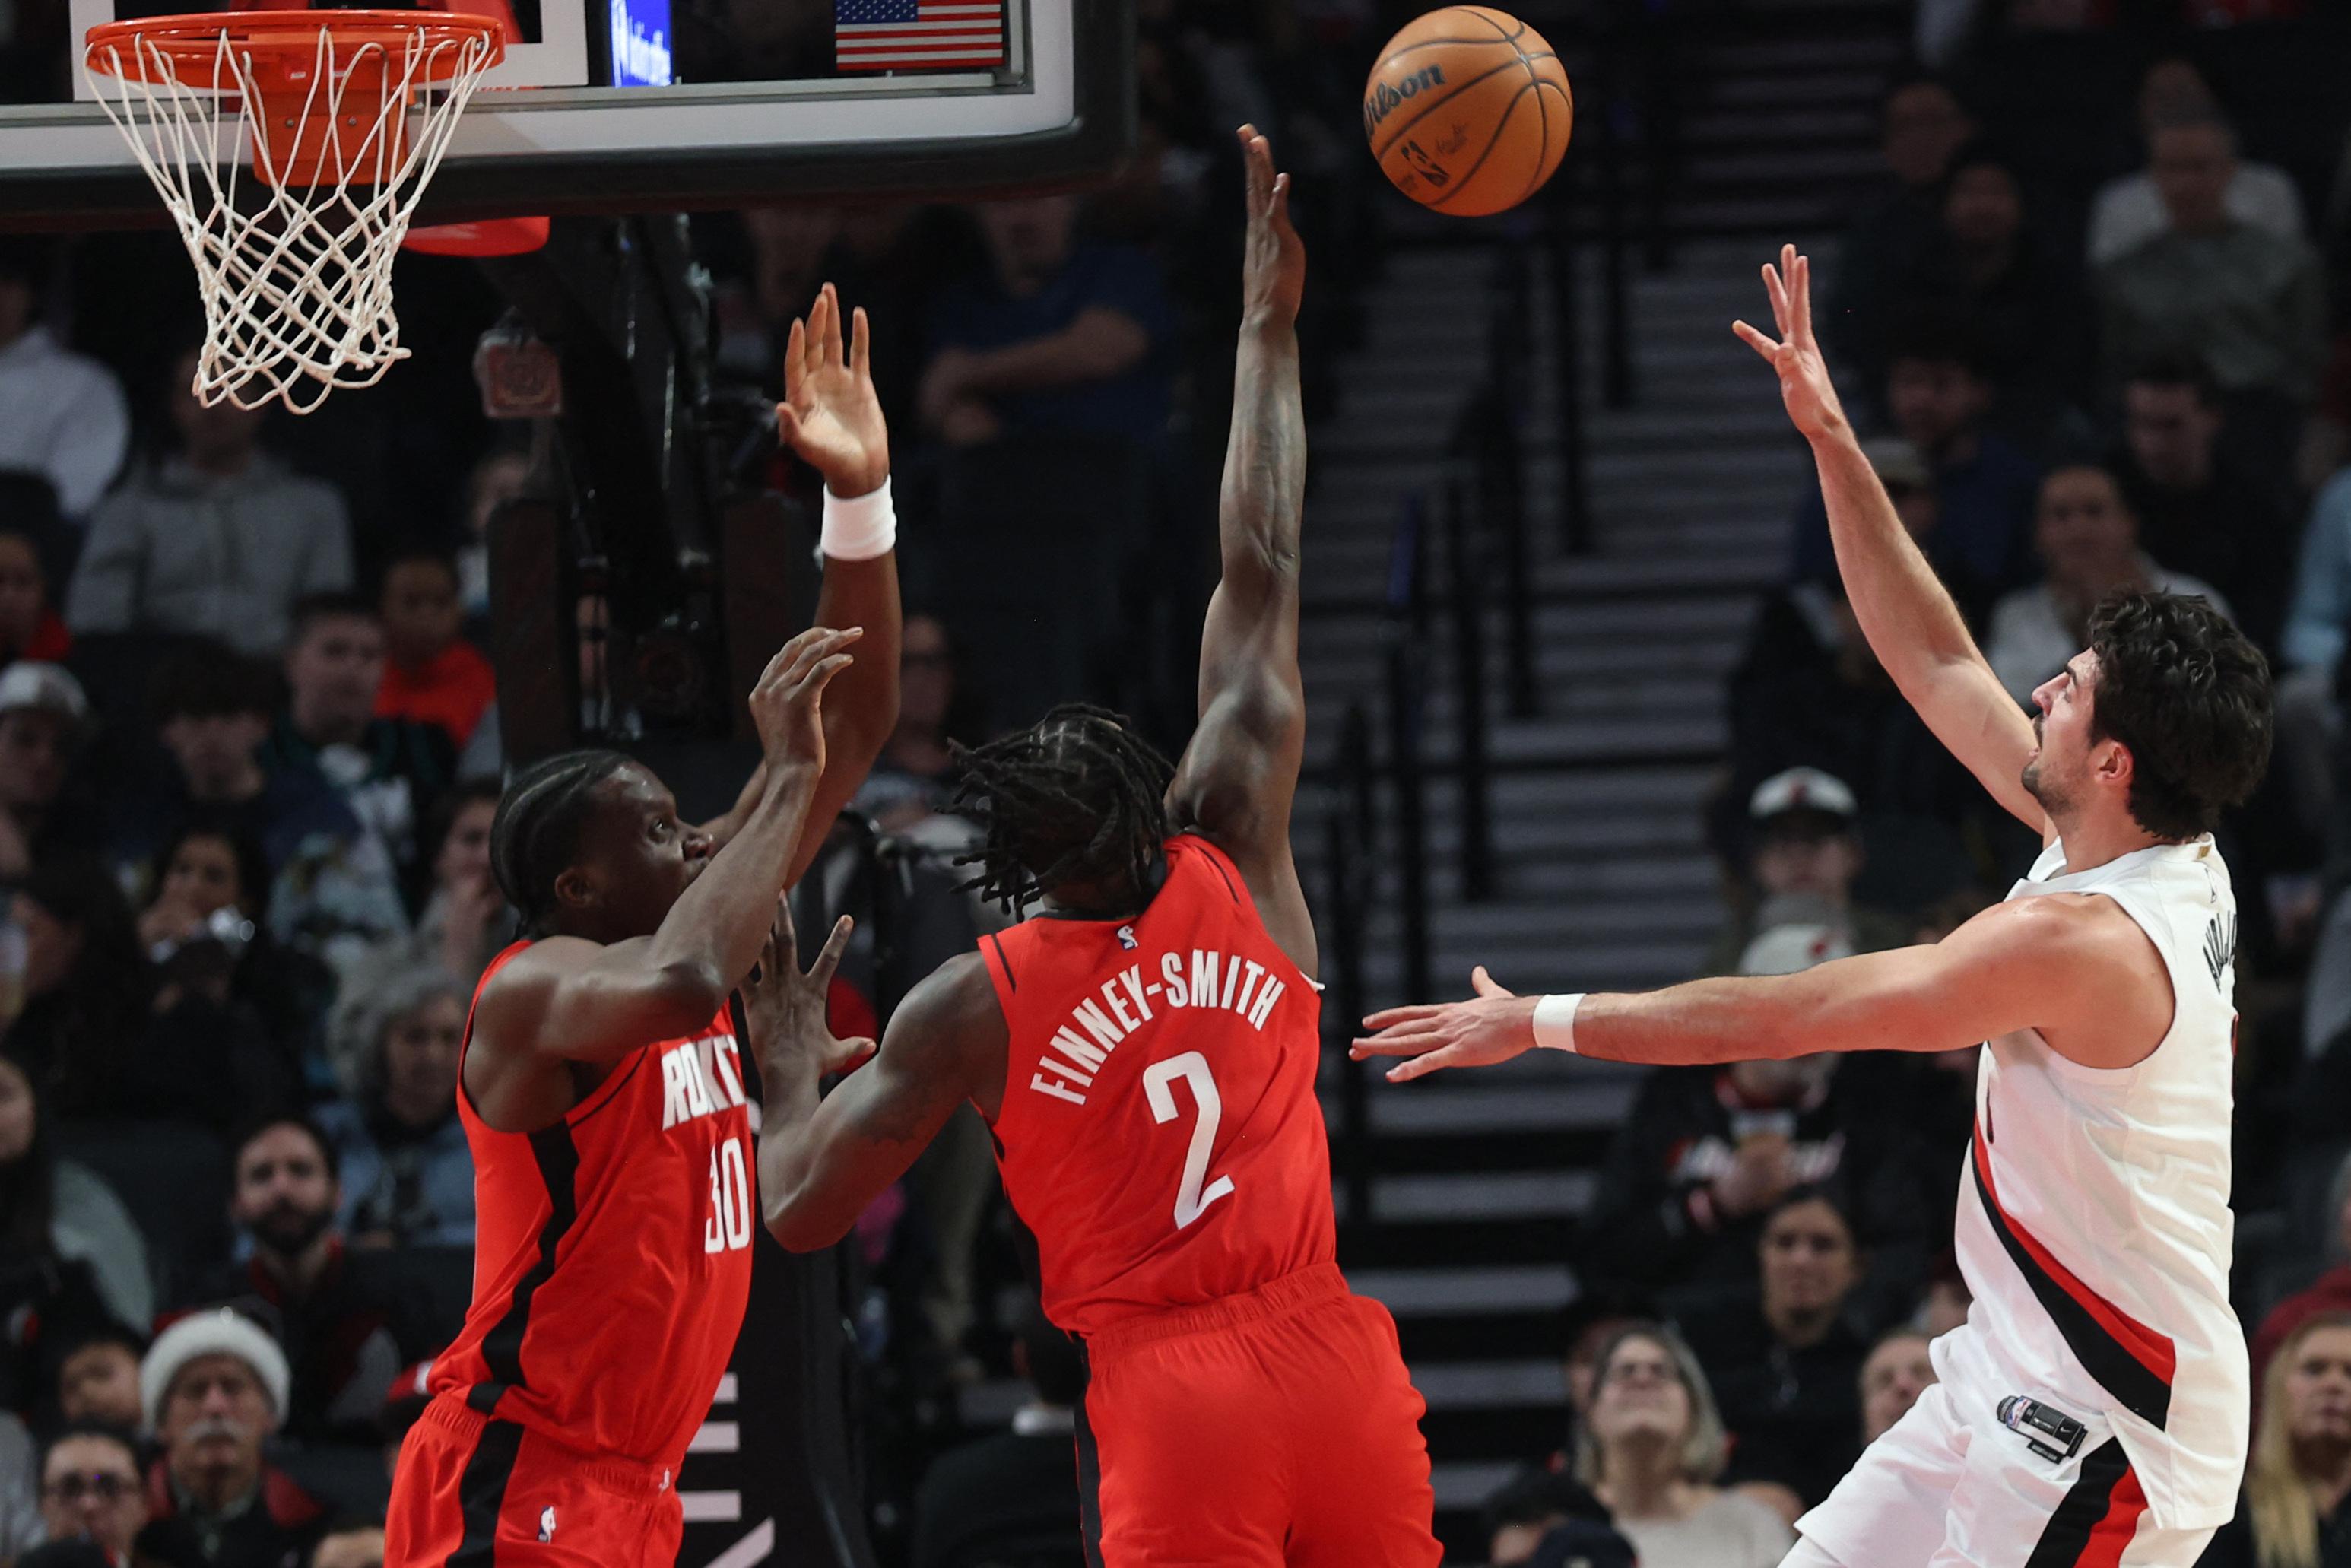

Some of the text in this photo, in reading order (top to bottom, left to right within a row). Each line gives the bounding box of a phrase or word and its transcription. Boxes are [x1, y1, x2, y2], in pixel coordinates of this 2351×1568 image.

[1030, 948, 1286, 1106] FINNEY-SMITH
[704, 1137, 750, 1253] 30
[1142, 1050, 1236, 1230] 2
